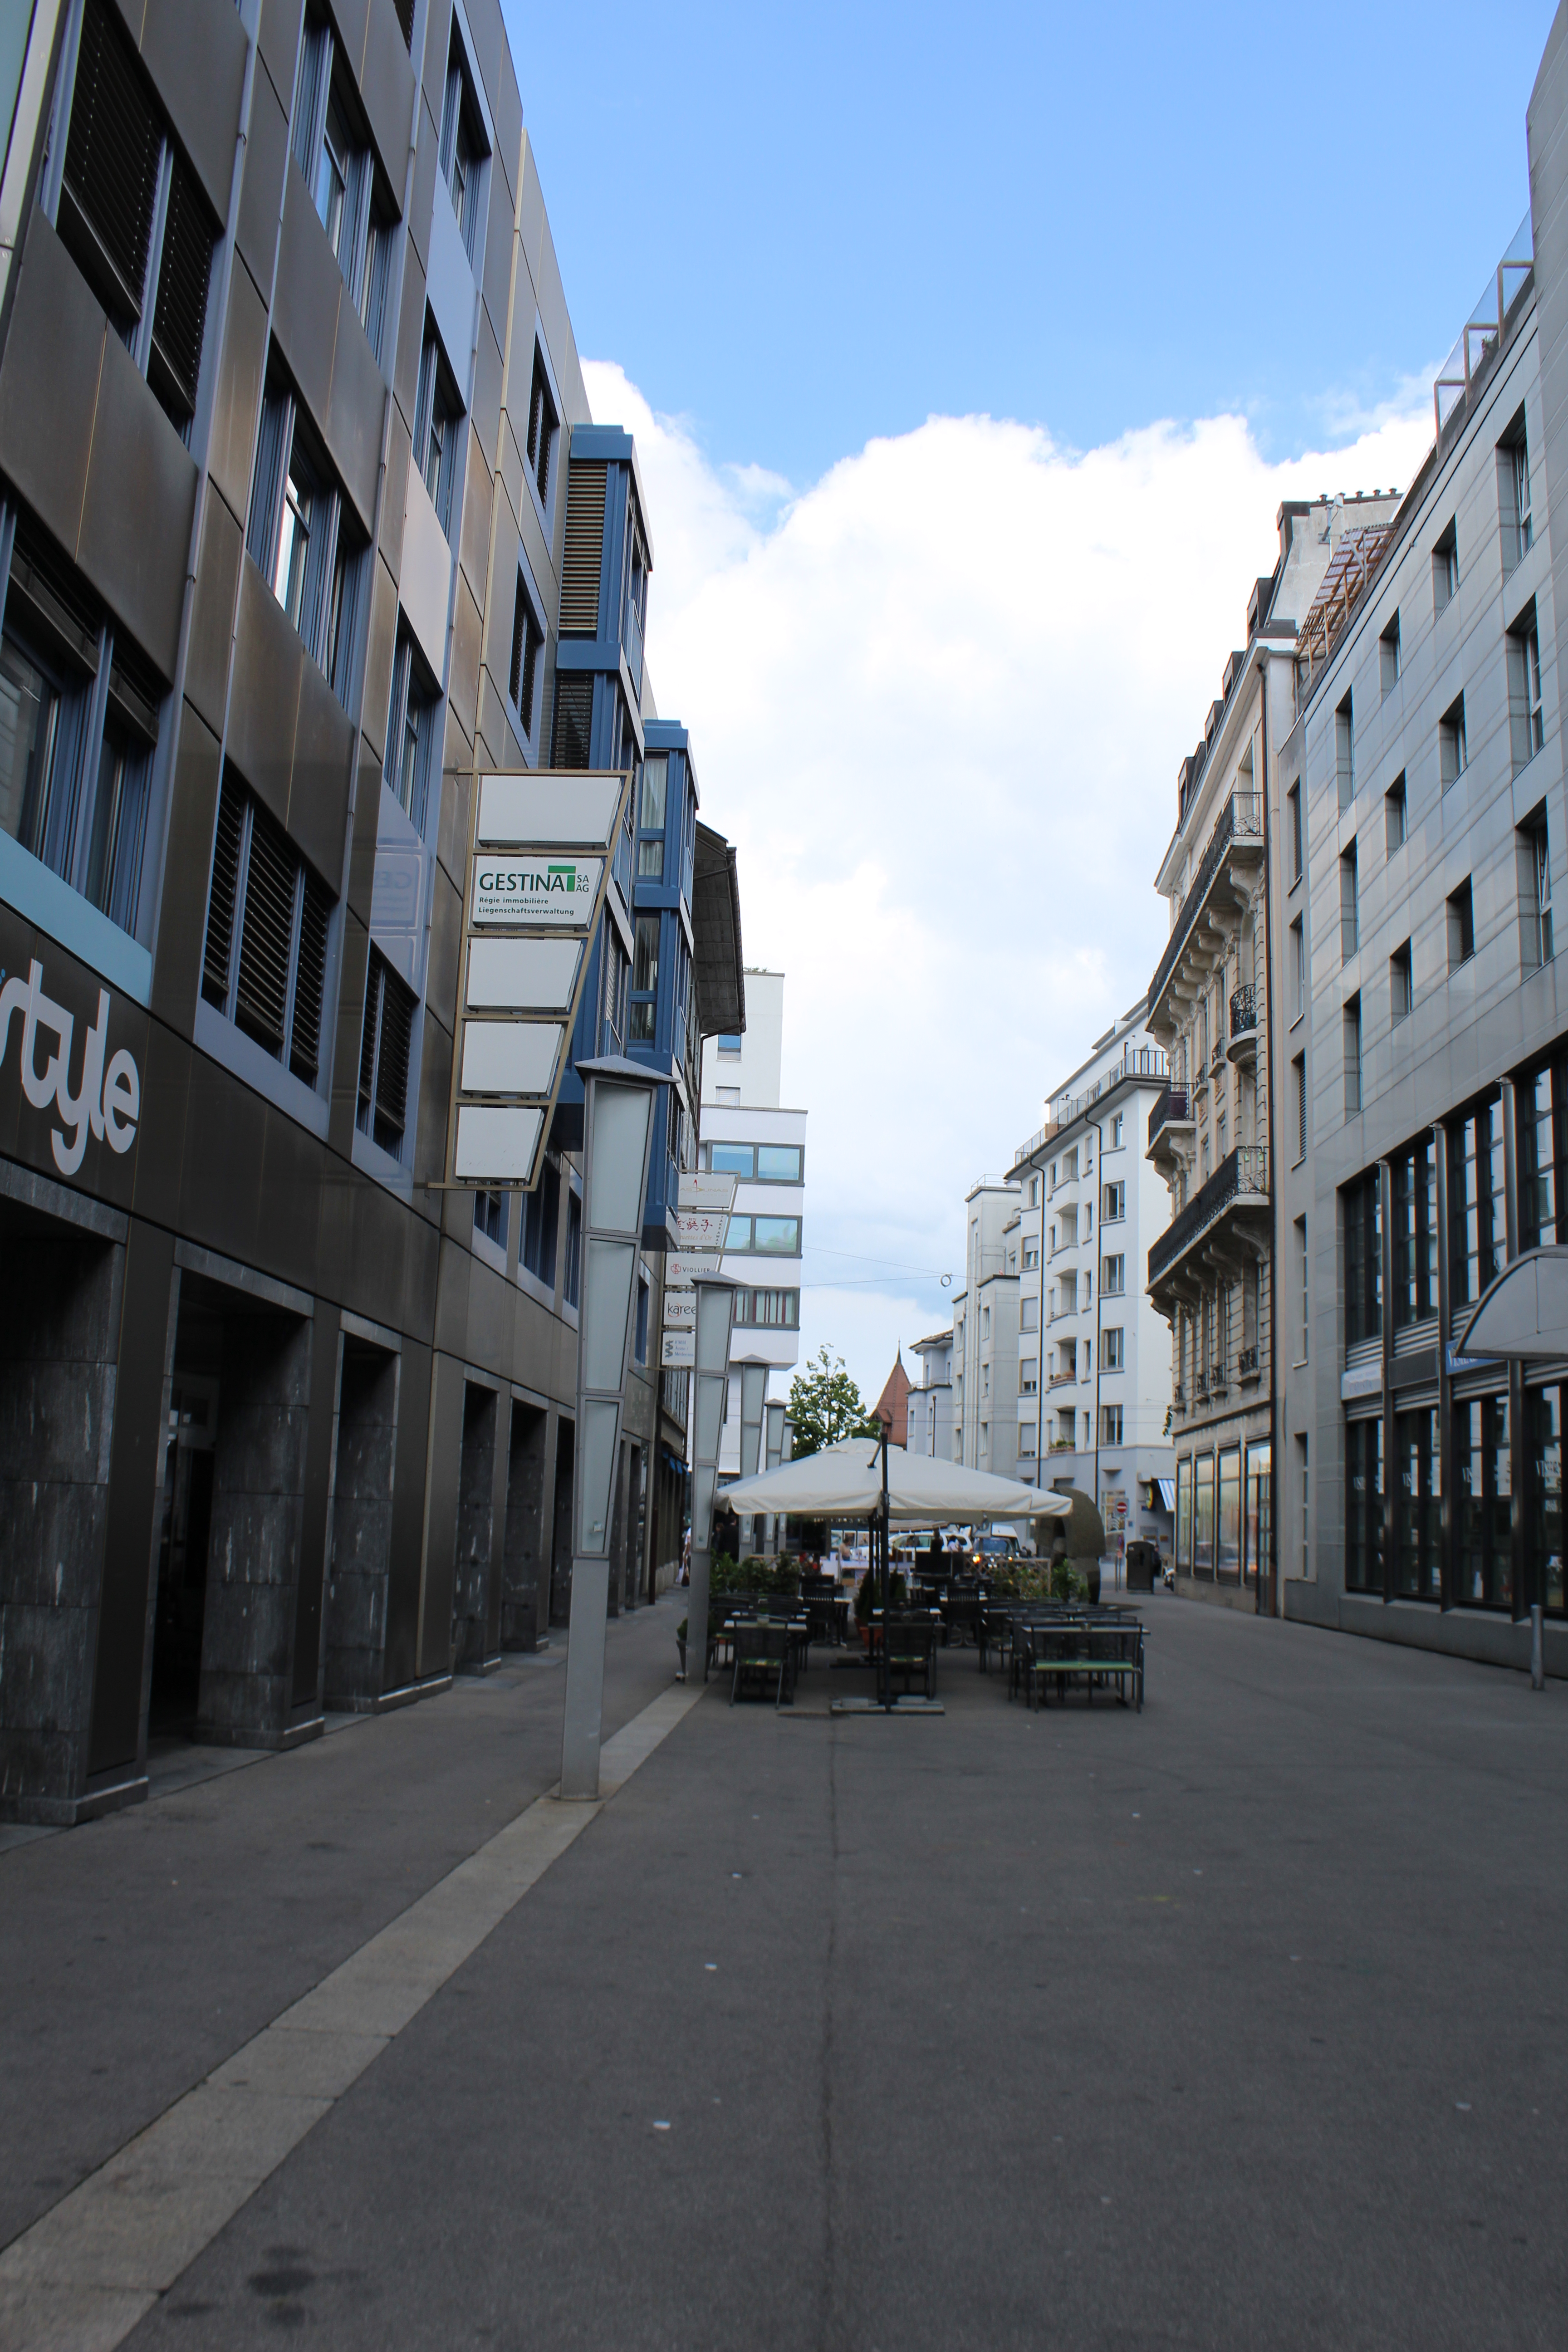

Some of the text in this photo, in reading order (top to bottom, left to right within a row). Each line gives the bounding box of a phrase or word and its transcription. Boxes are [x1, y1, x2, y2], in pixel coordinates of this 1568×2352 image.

[577, 875, 589, 883] SA
[575, 884, 589, 892] AG
[479, 907, 574, 916] Liegenschaftsverwaltung
